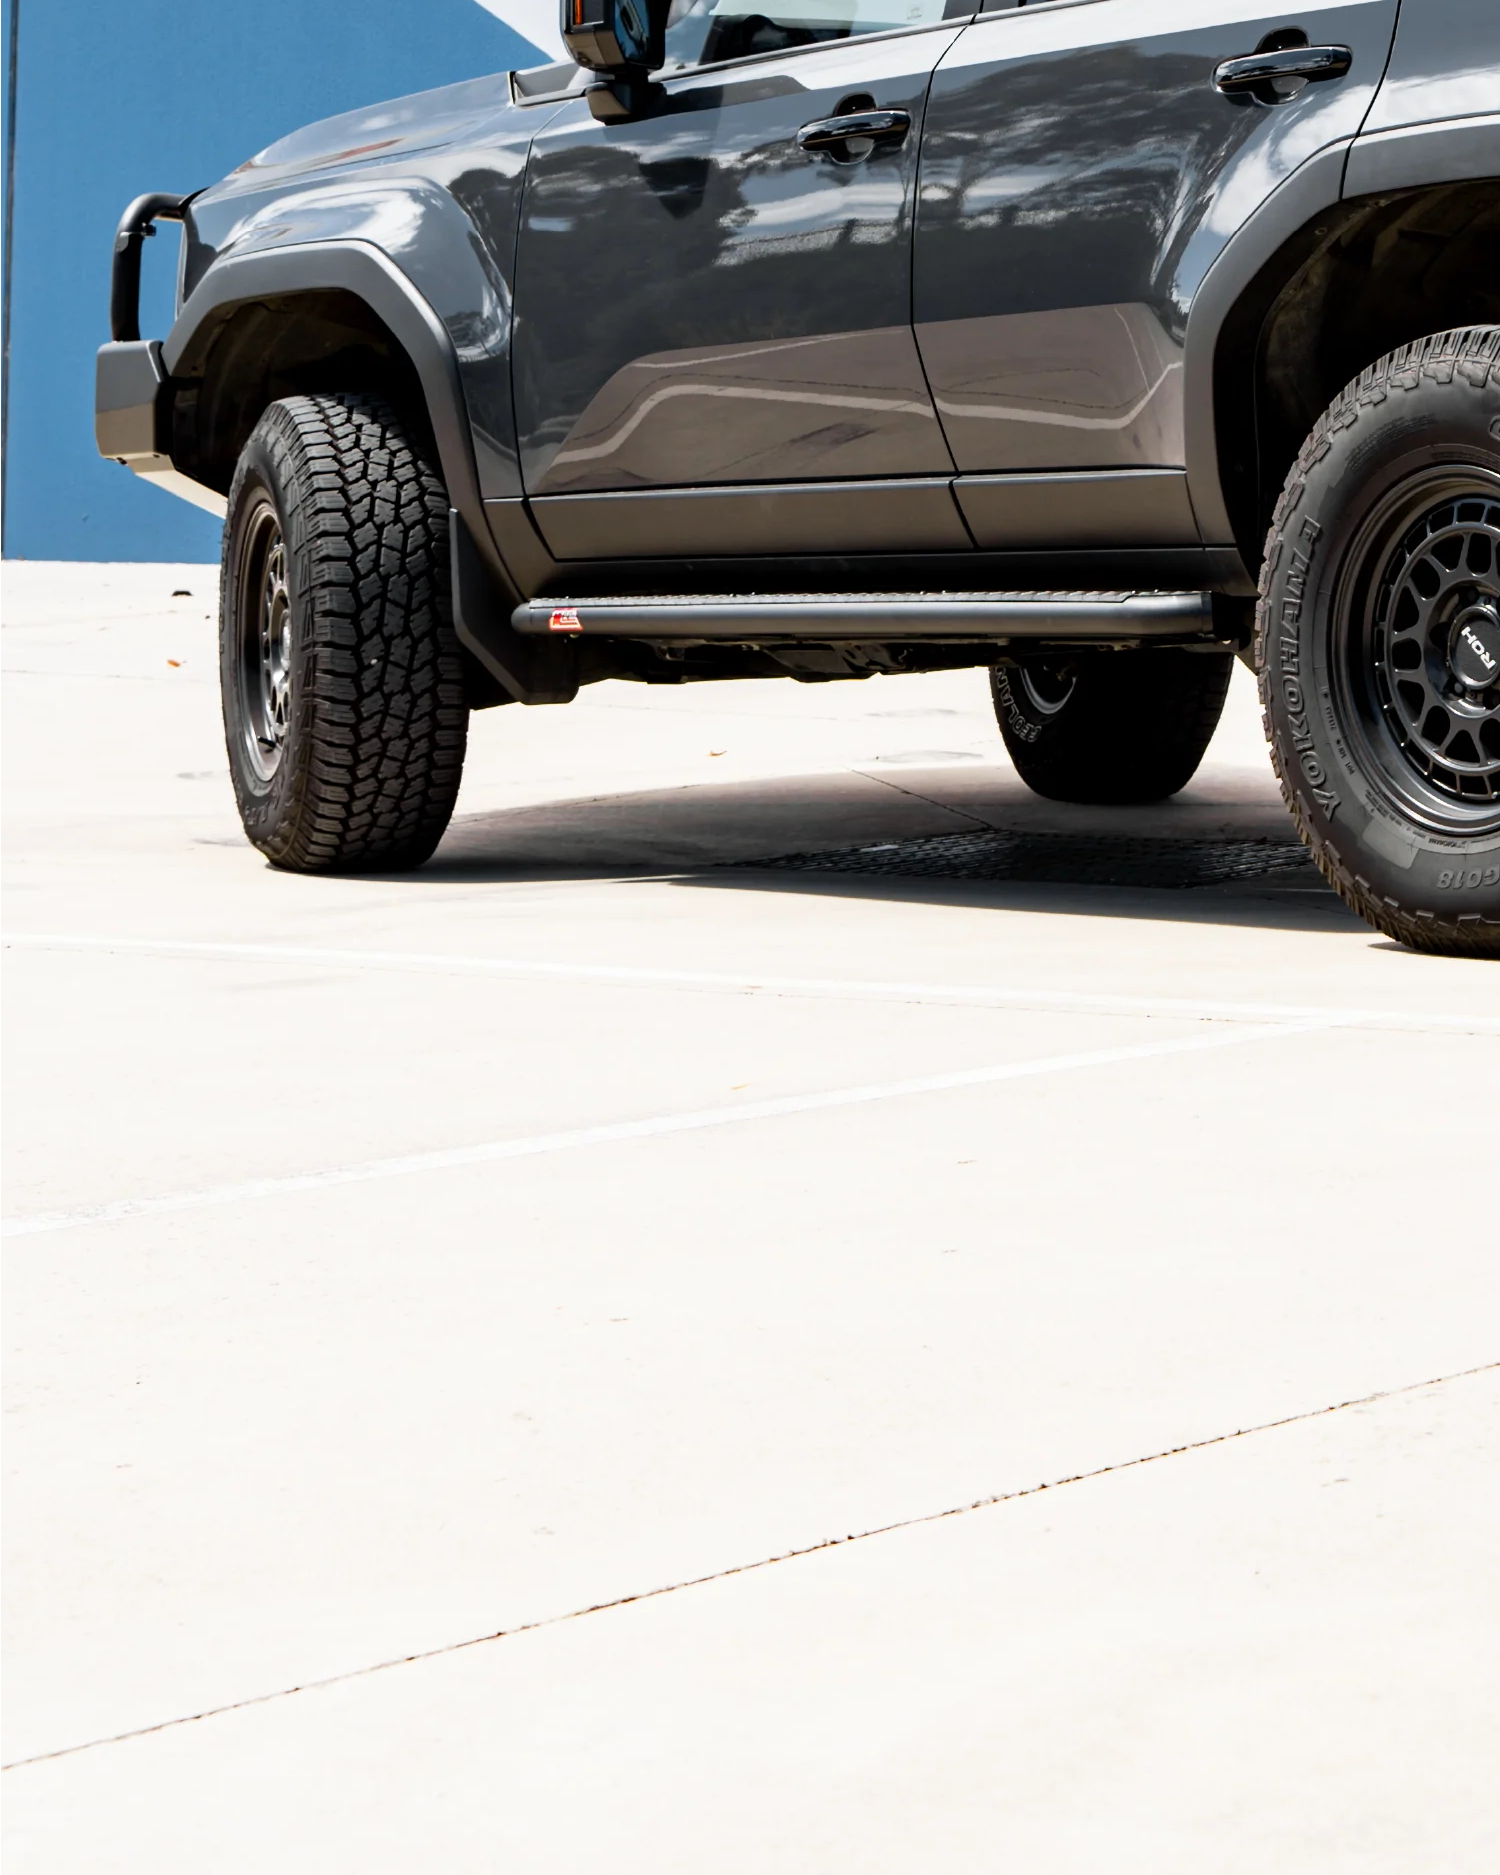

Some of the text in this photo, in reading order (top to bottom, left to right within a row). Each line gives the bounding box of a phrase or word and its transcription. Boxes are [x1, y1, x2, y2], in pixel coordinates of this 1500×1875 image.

[1279, 514, 1341, 822] YOKOHAMA
[1461, 626, 1497, 670] ROH
[1436, 862, 1500, 891] G018
